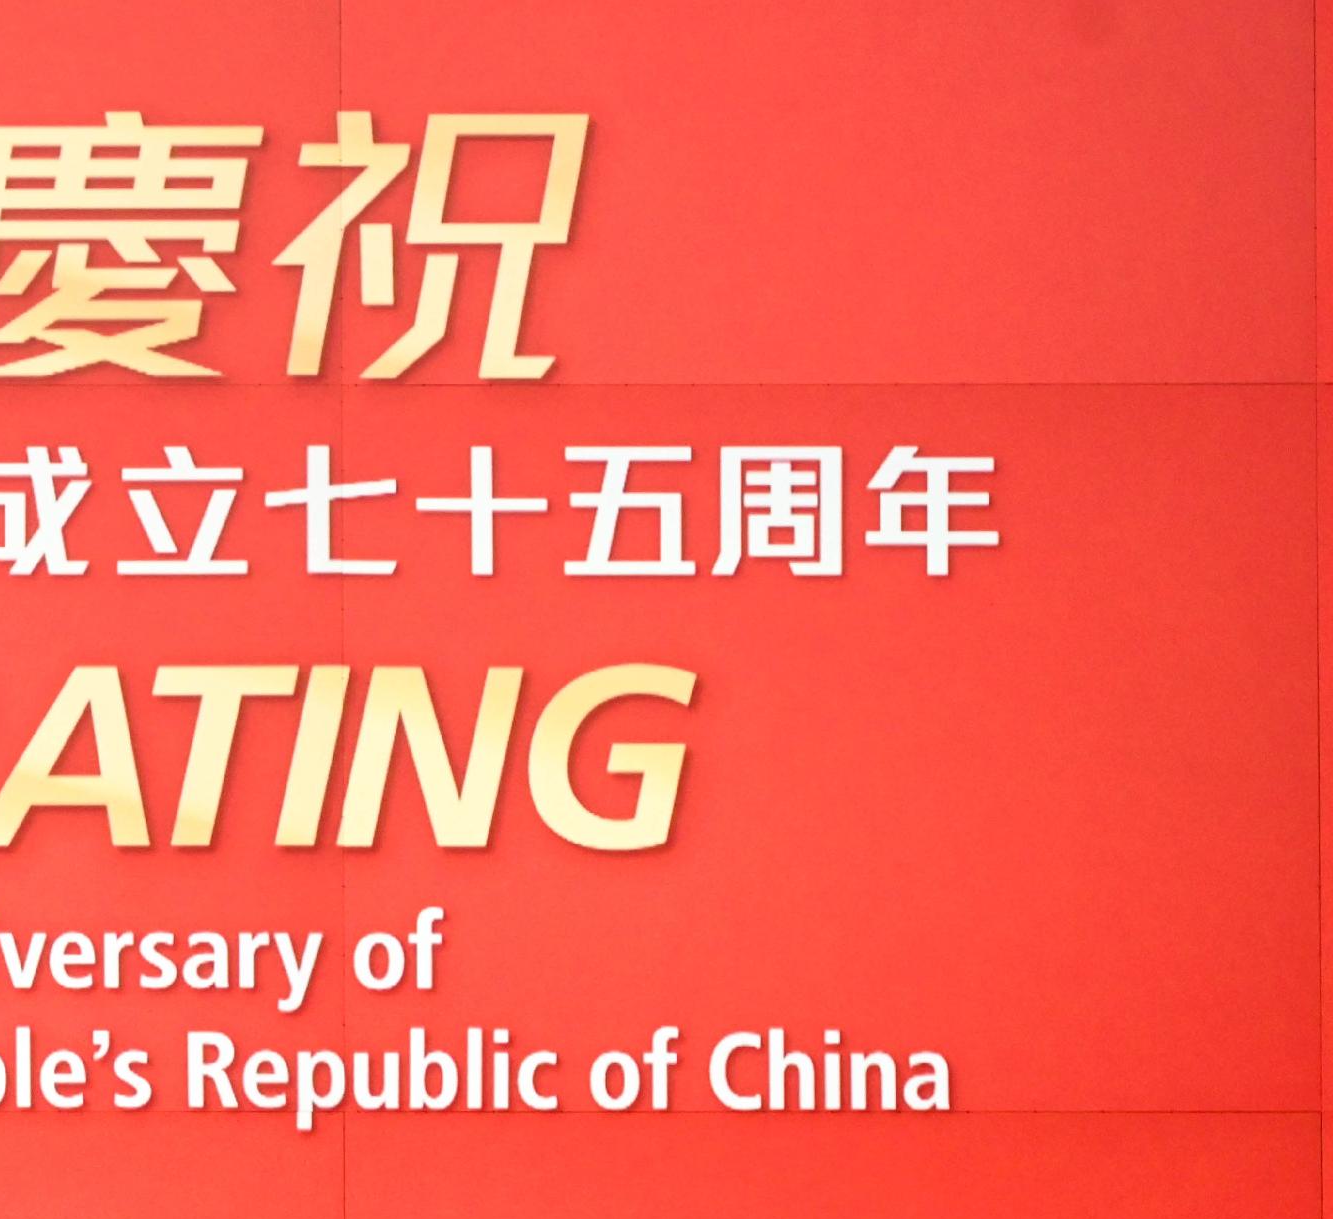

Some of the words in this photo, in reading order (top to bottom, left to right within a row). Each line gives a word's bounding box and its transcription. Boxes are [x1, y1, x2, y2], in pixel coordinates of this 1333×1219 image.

[353, 907, 444, 989] of
[186, 1027, 558, 1131] Republic
[589, 1026, 680, 1110] of
[708, 1028, 951, 1111] China
